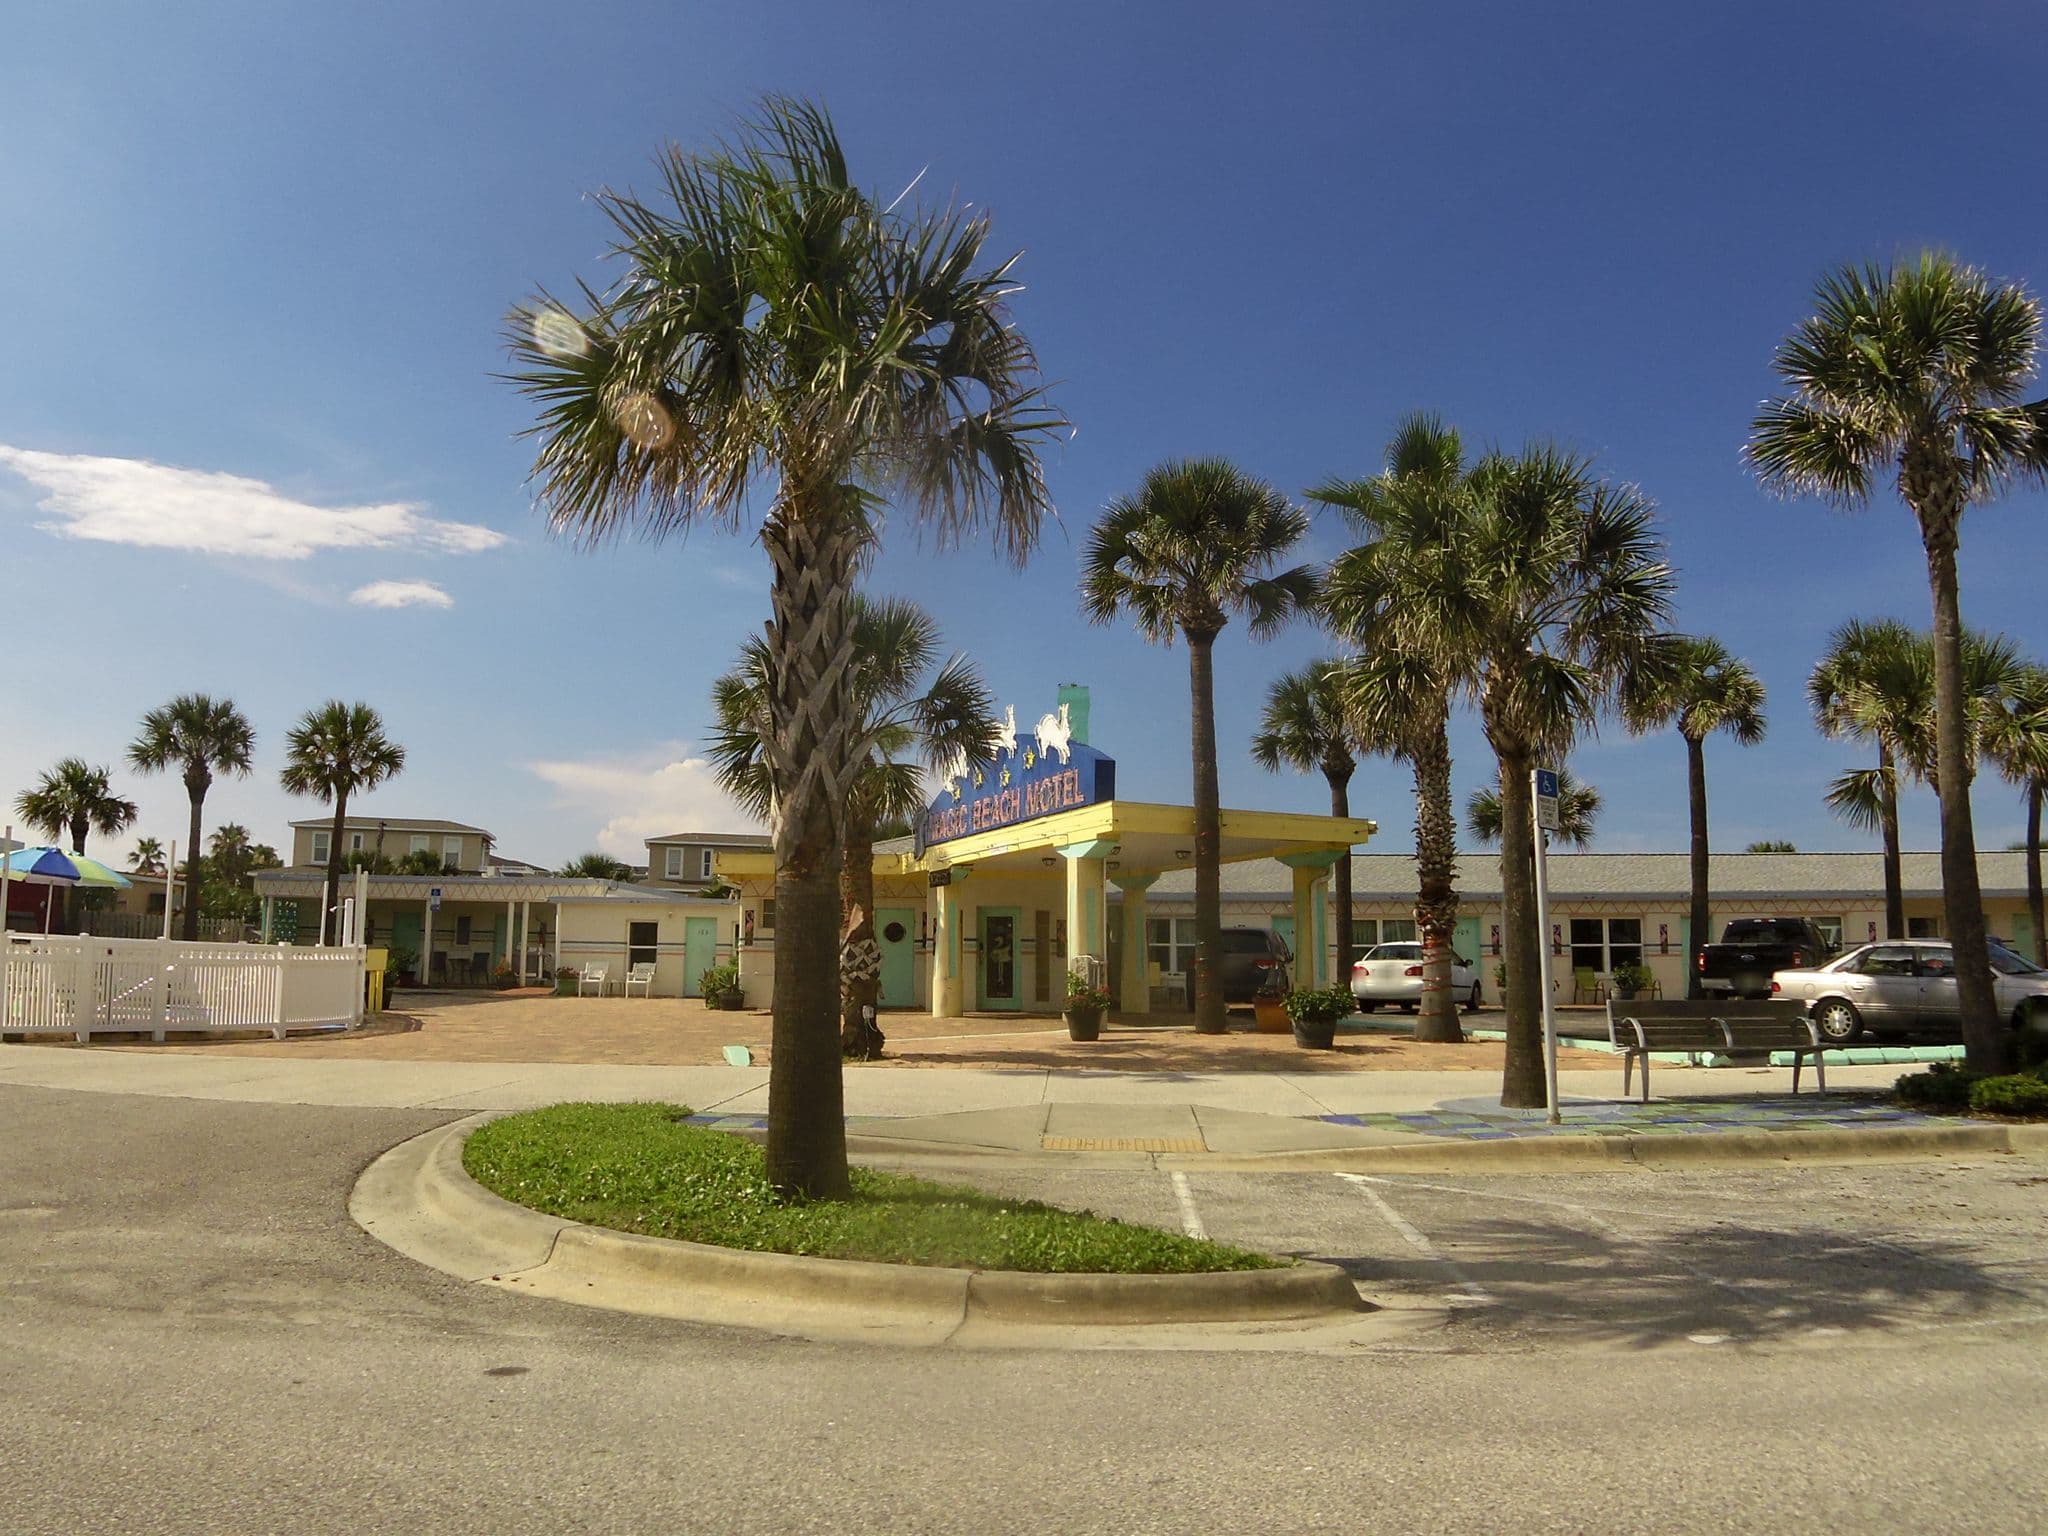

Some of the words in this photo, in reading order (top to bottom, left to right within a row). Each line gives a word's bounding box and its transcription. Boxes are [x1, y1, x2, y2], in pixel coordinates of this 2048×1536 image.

[930, 805, 968, 840] MAGIC
[973, 788, 1020, 829] BEACH
[1026, 769, 1084, 815] MOTEL
